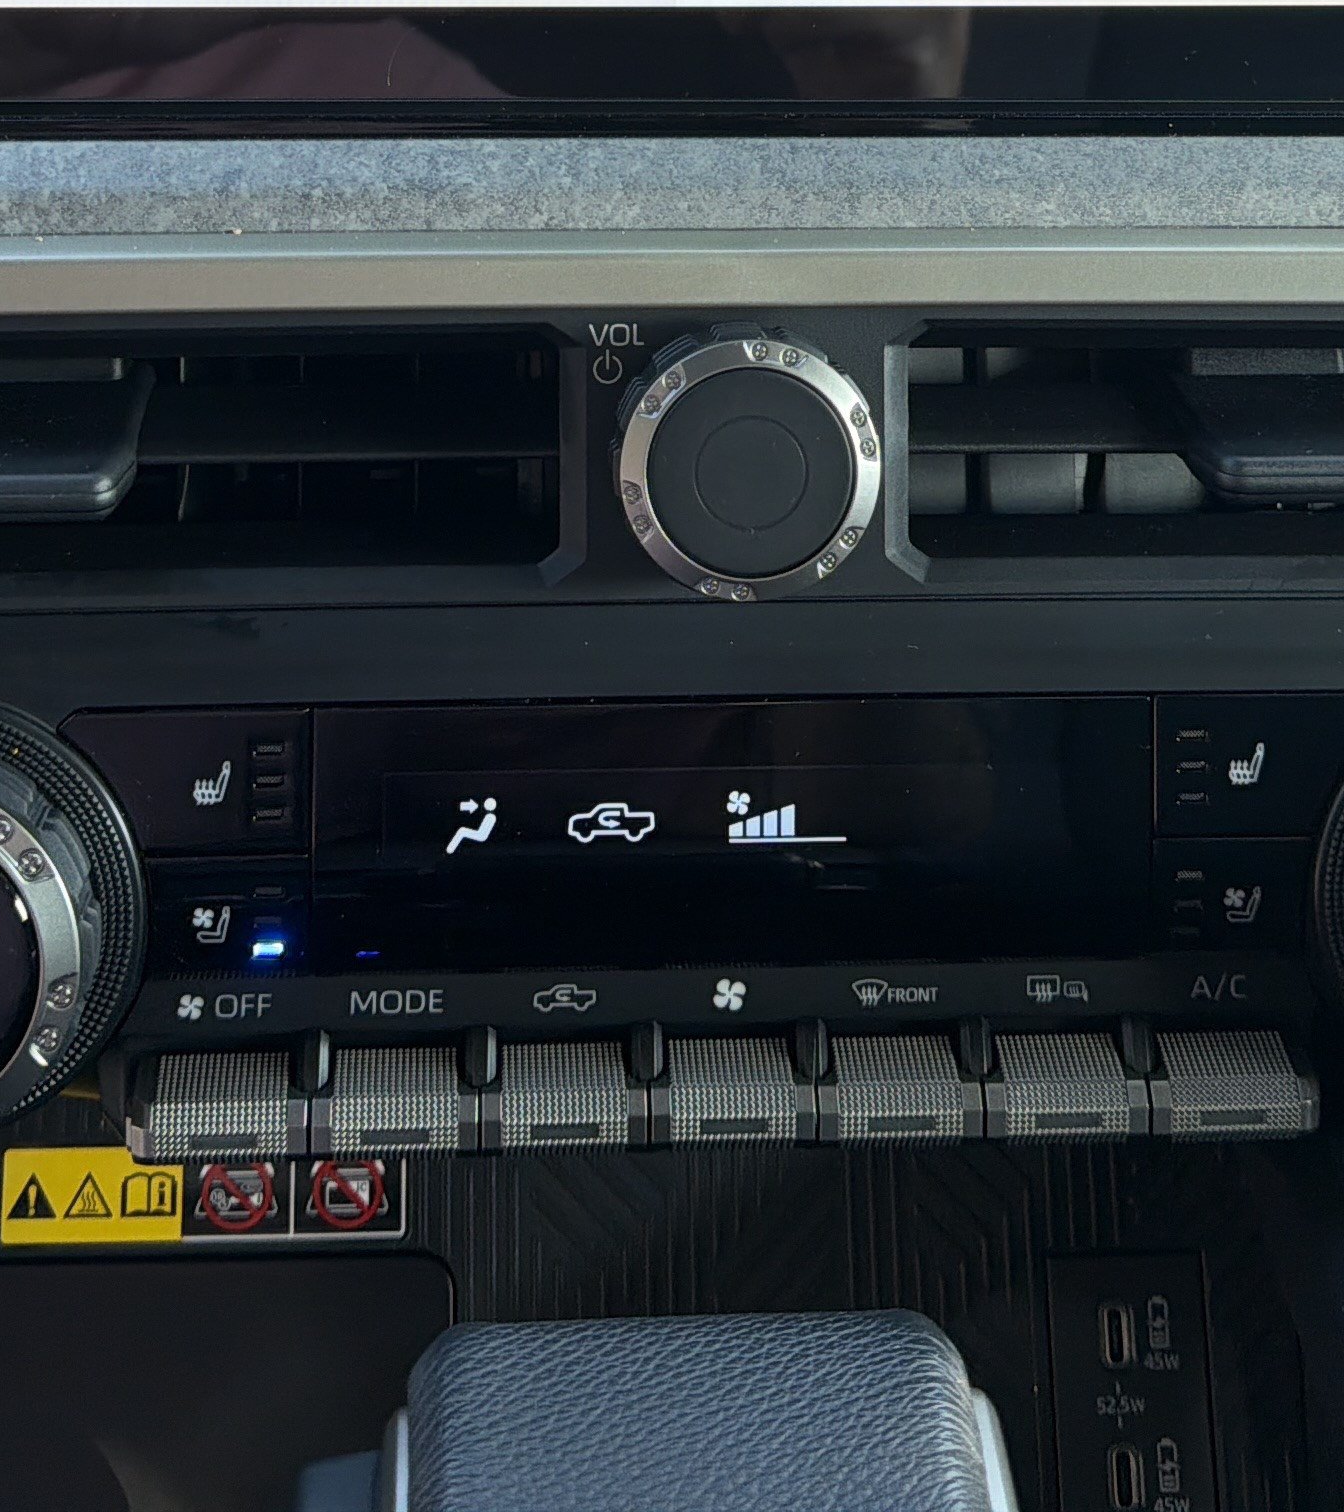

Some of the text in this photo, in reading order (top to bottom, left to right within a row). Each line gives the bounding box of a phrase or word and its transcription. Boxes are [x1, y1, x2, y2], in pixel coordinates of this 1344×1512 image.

[589, 324, 643, 346] VOL
[887, 984, 939, 1003] FRONT
[1191, 974, 1245, 1000] A/C
[215, 994, 271, 1018] OFF
[351, 990, 443, 1014] MODE
